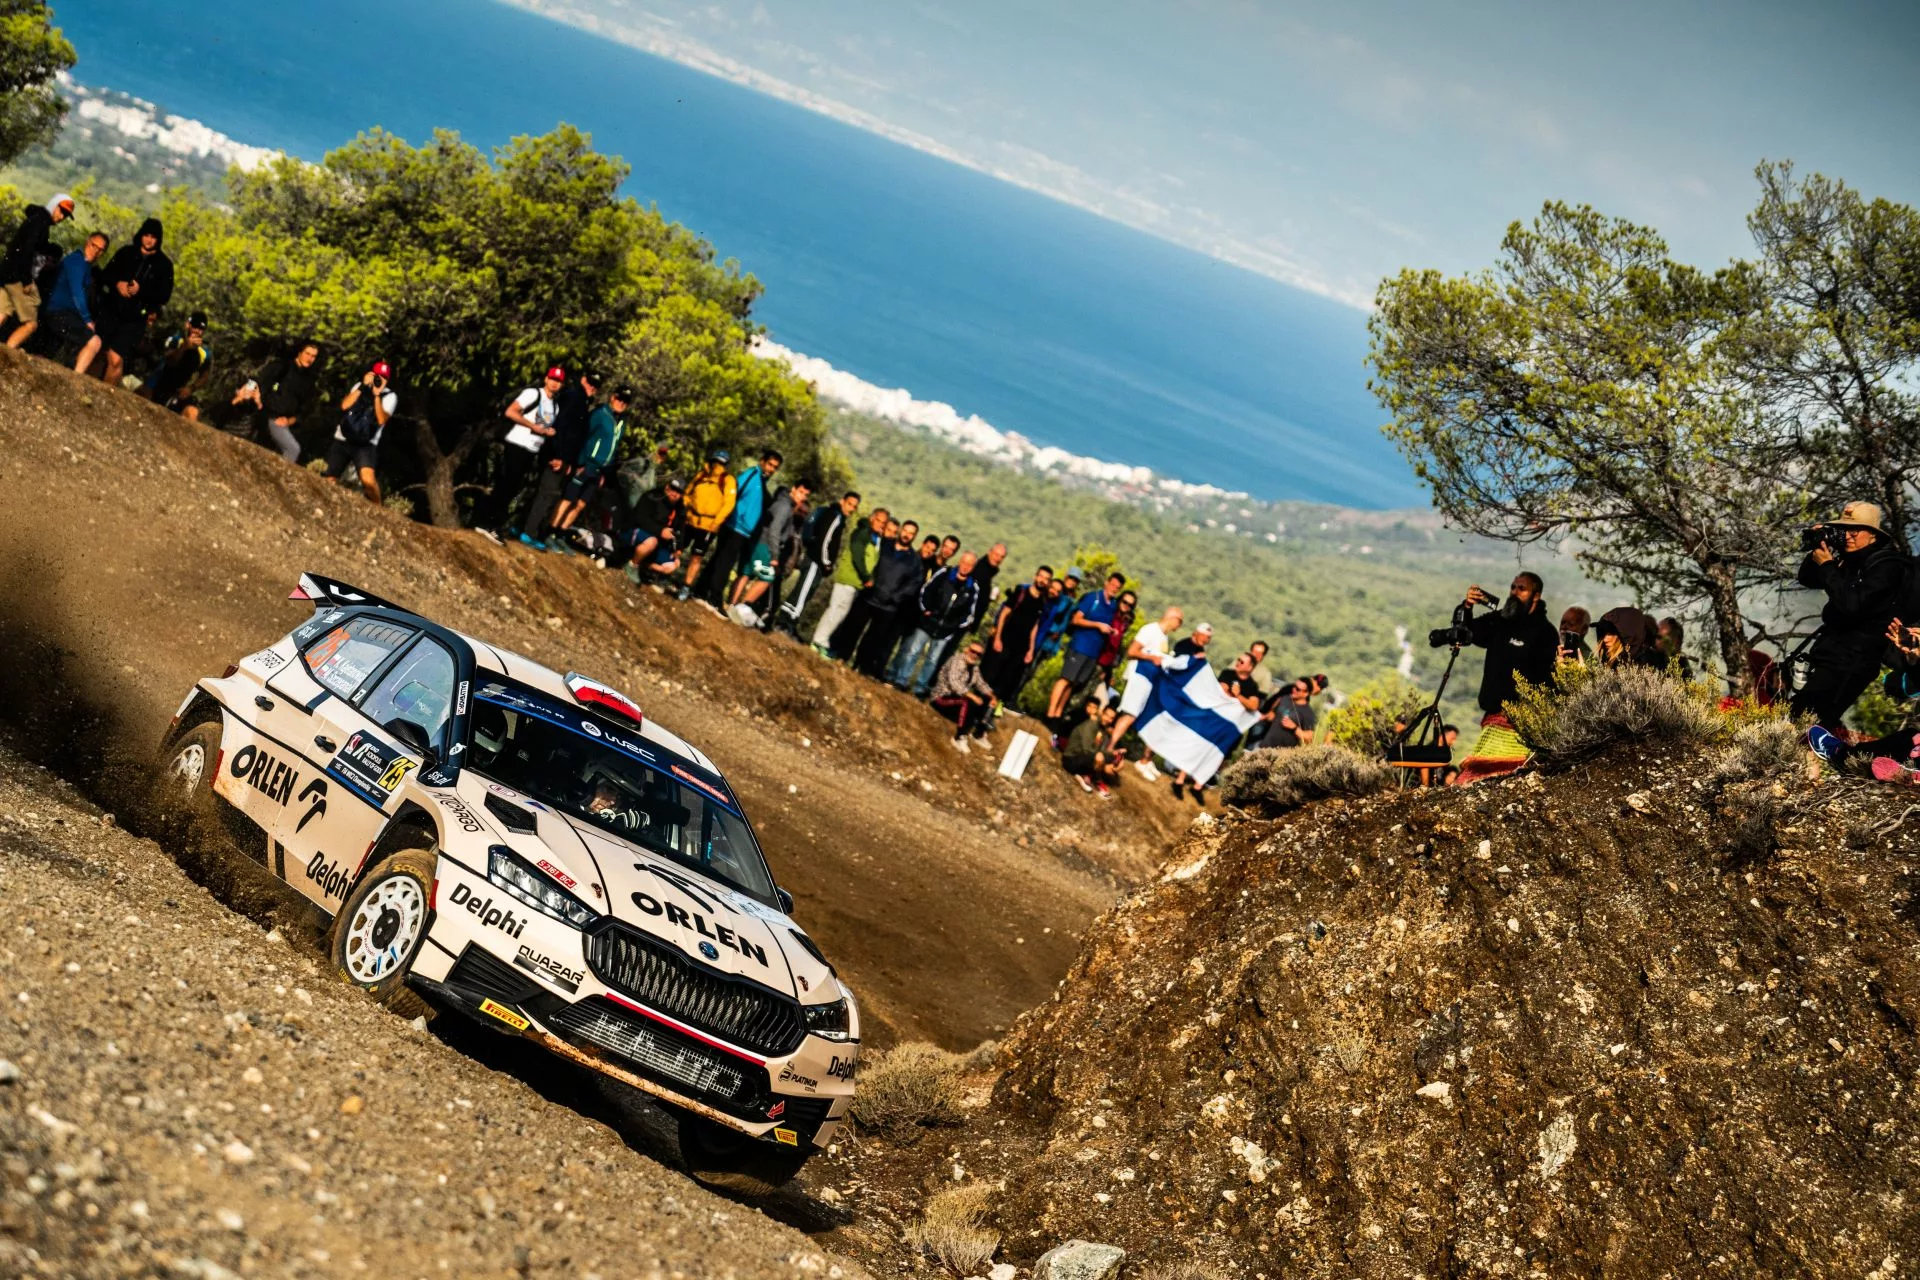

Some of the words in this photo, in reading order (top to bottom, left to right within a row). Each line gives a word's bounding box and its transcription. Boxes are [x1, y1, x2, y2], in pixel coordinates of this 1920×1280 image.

[605, 732, 656, 762] WRC
[230, 744, 299, 806] ORLEN
[378, 757, 417, 791] 25
[539, 860, 560, 876] S2161
[559, 874, 576, 888] BCJ
[450, 883, 528, 939] Delphi
[631, 892, 769, 967] ORLEN
[518, 944, 583, 984] QUAZAR
[485, 1002, 525, 1027] PIRELLI
[791, 1074, 818, 1088] PLATINUM
[826, 1055, 855, 1082] Delph
